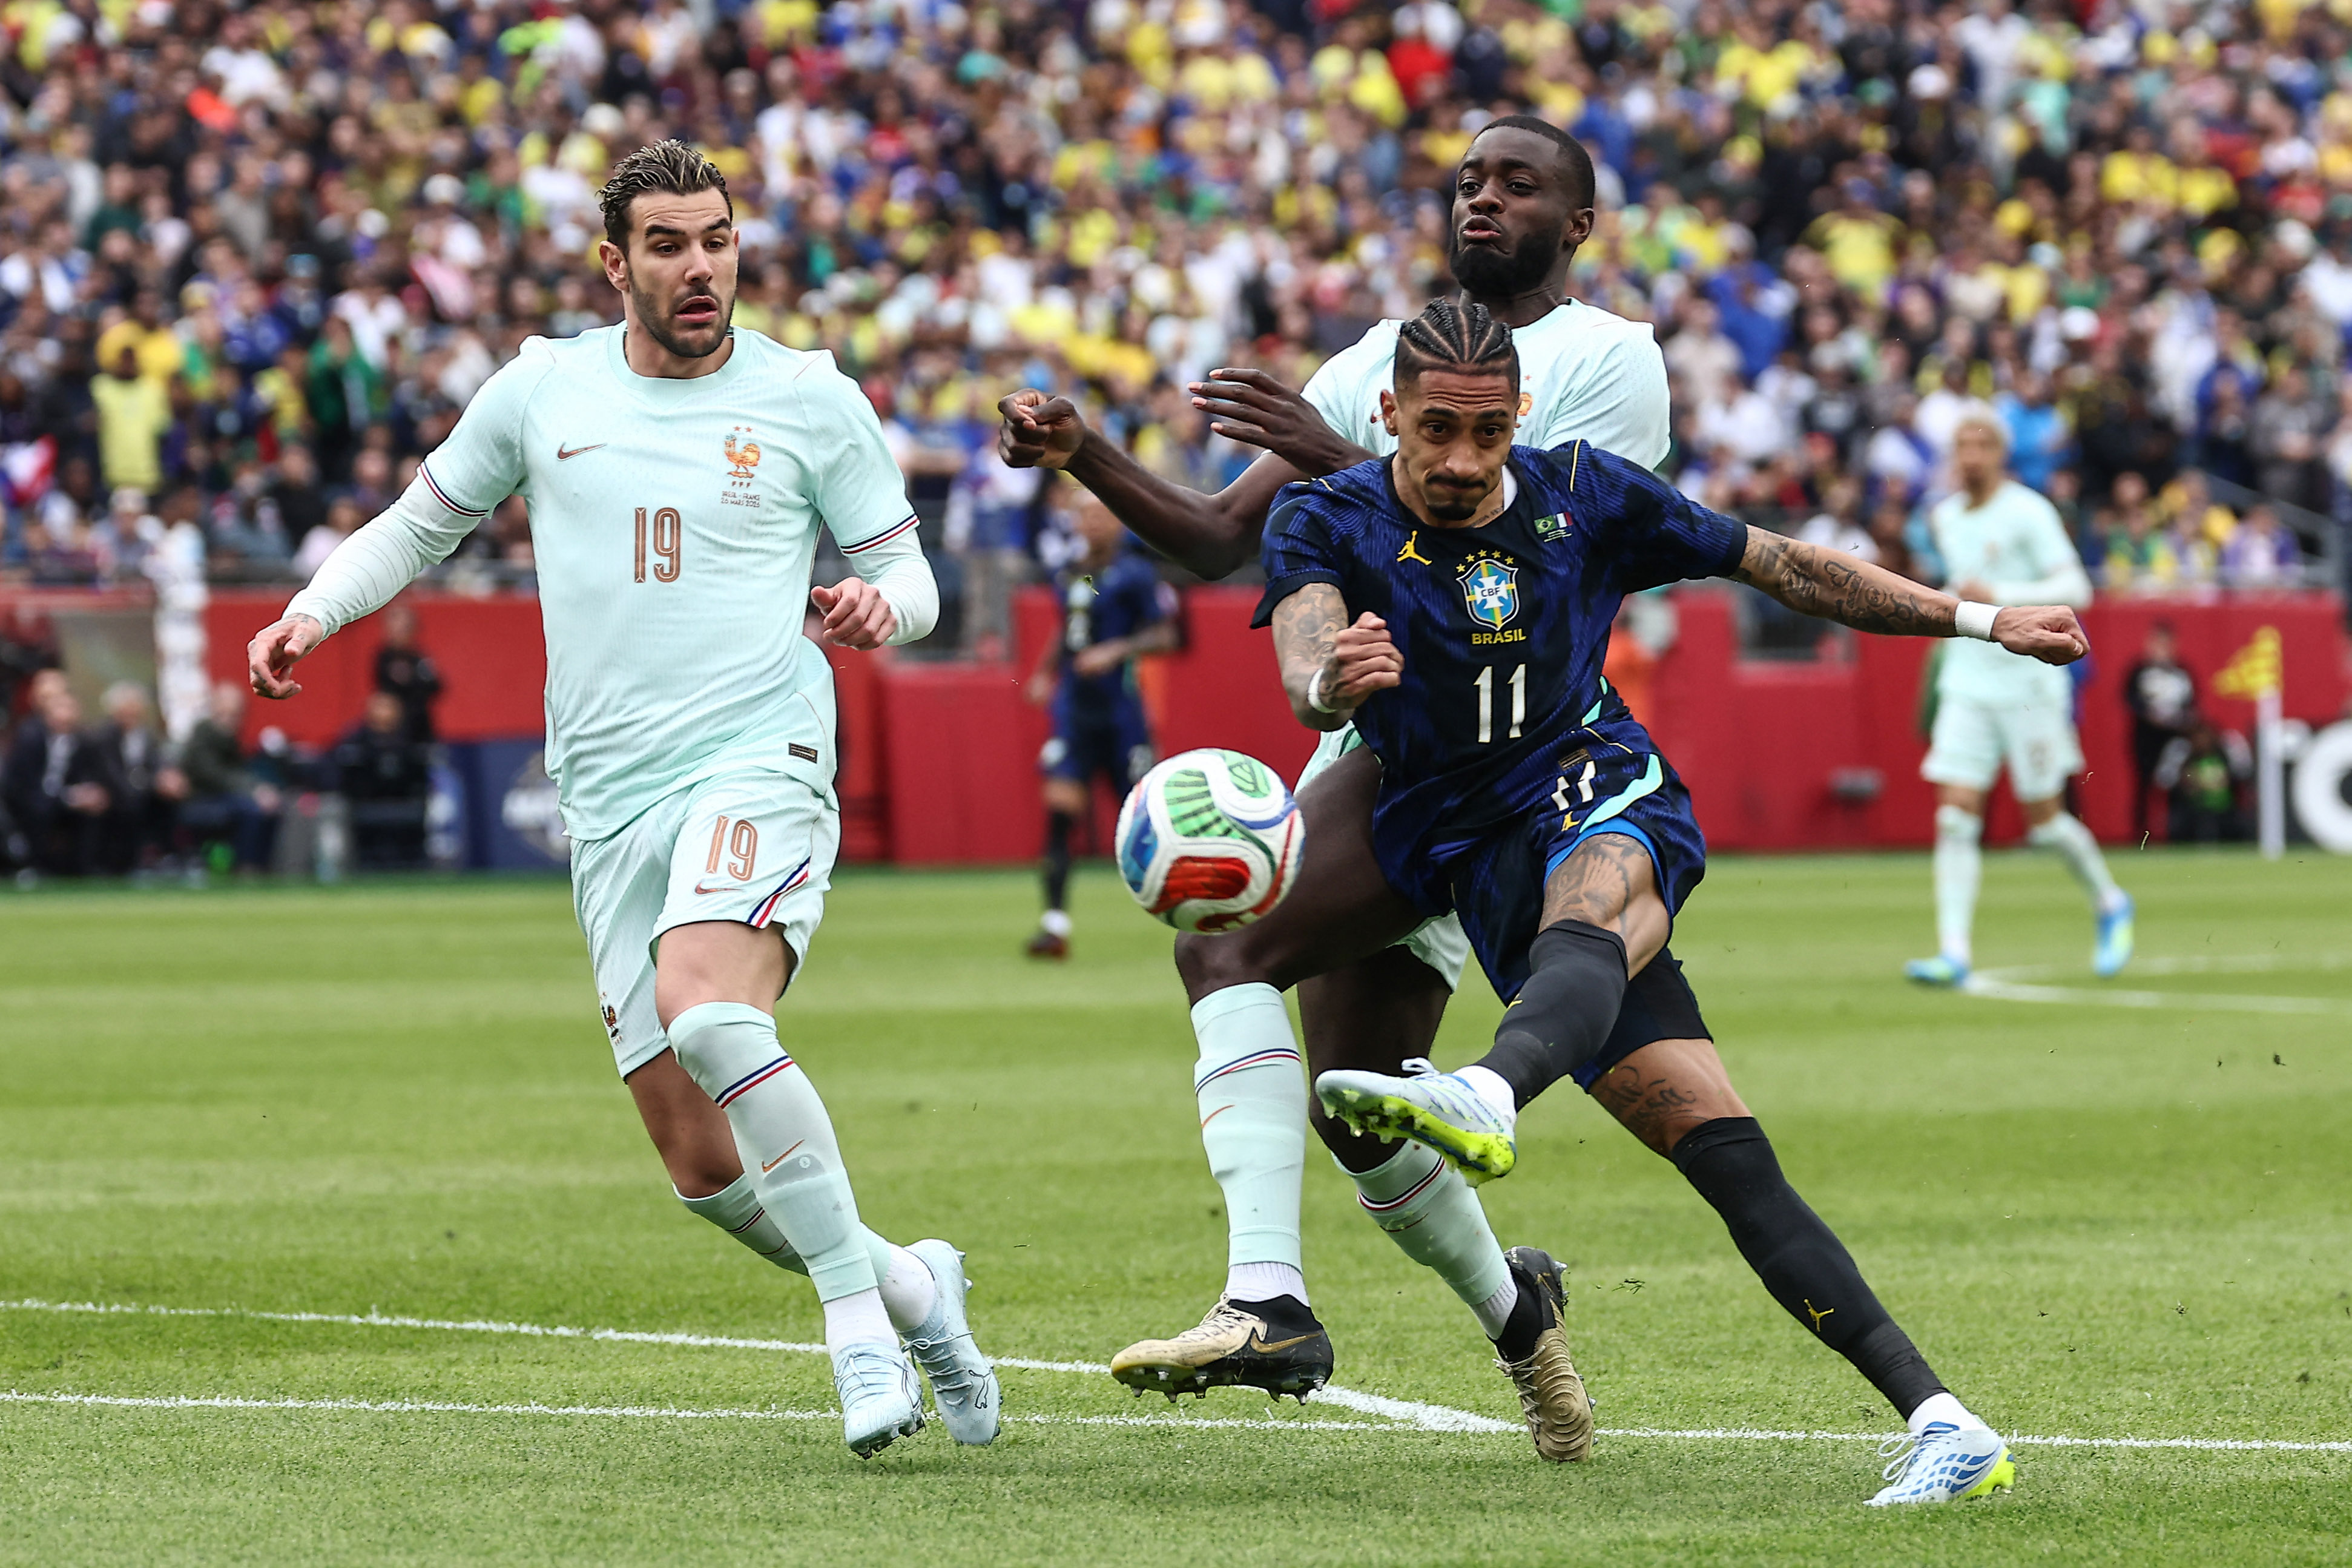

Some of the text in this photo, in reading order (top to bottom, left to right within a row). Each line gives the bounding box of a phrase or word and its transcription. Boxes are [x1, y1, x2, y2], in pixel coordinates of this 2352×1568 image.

[634, 507, 680, 583] 19
[1481, 587, 1500, 597] CBF
[1472, 628, 1527, 645] BRASIL
[1474, 664, 1526, 743] 11
[1550, 760, 1596, 811] 11
[706, 815, 758, 881] 19
